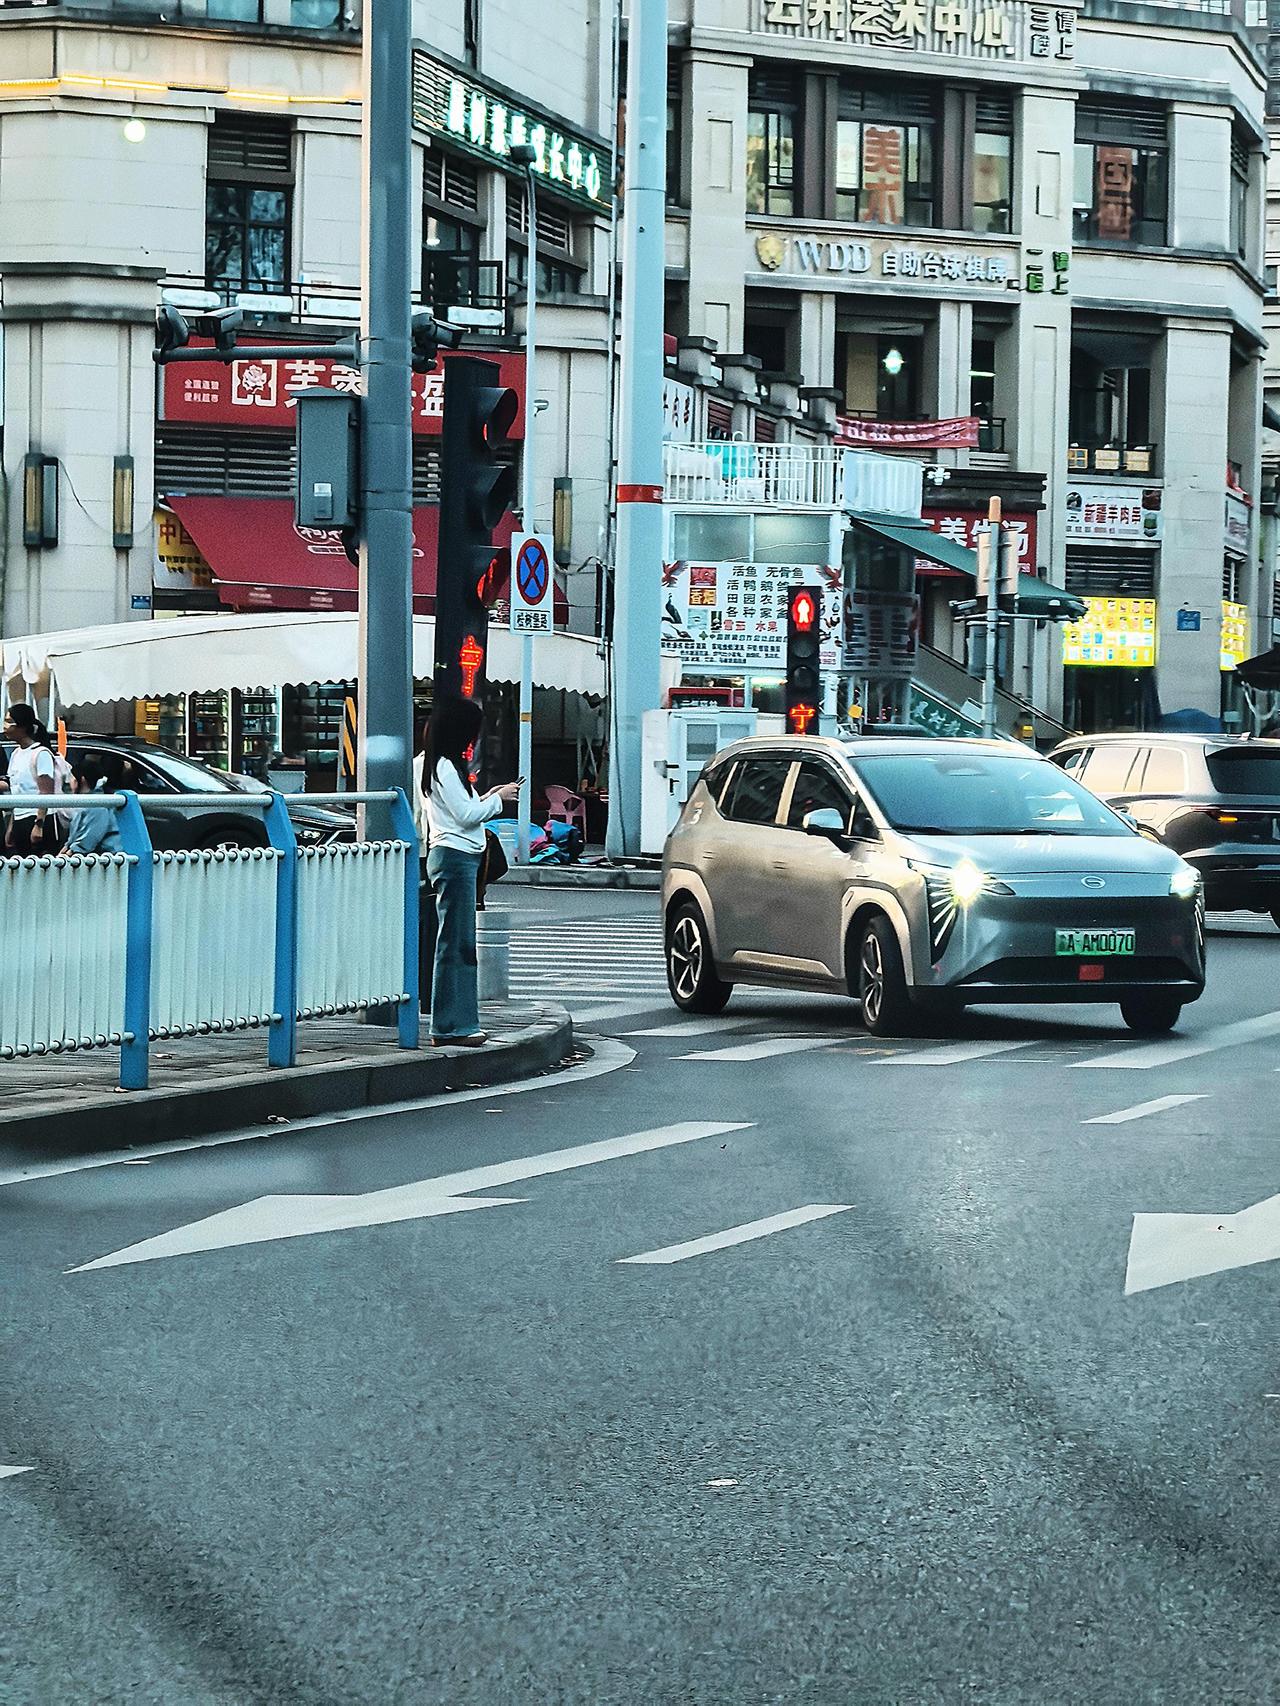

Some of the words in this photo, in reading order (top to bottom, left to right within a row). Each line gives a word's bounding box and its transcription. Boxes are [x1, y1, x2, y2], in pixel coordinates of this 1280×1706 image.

[794, 238, 872, 273] WDD
[881, 250, 1008, 282] 自助台球棋牌
[732, 565, 758, 578] 活鱼
[765, 566, 804, 579] 无骨鱼
[727, 579, 805, 592] 活鸭鹅鸽
[755, 620, 778, 632] 水果
